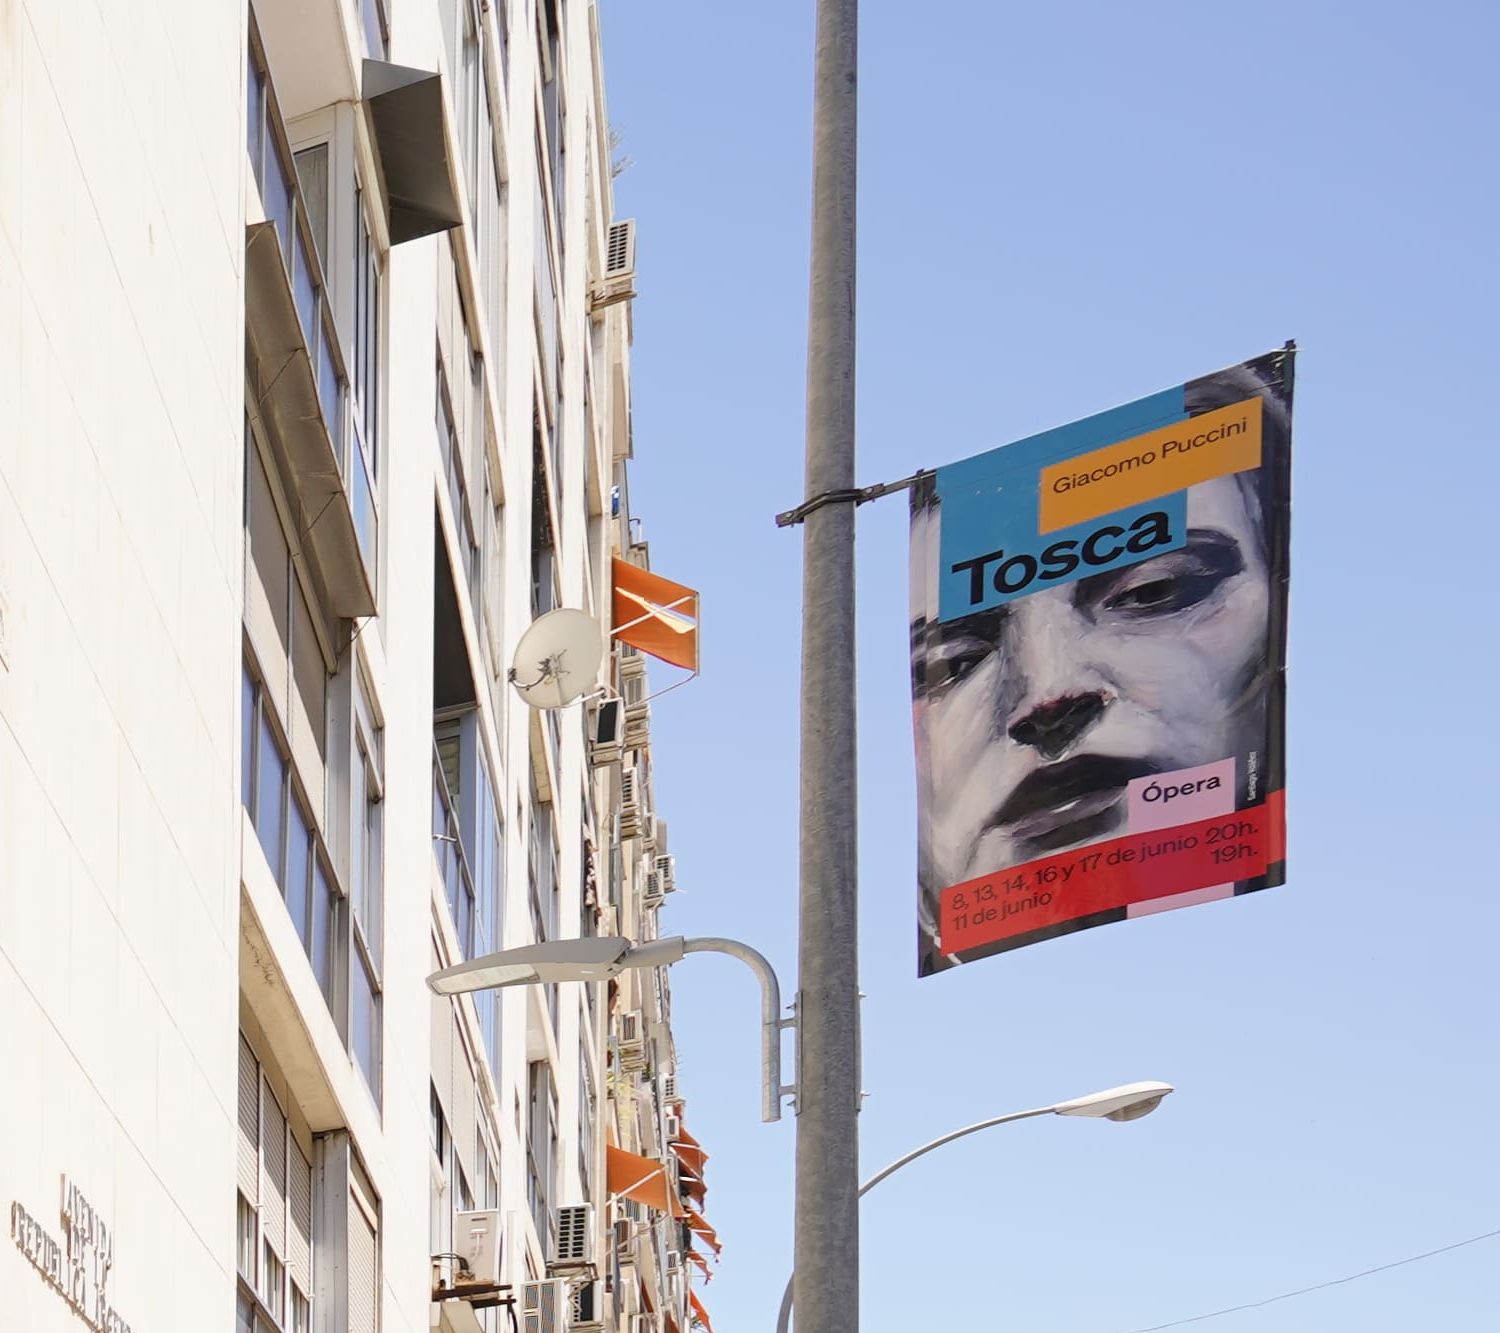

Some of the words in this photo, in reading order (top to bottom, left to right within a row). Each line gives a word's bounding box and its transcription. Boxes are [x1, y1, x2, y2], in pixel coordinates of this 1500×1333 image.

[1052, 447, 1156, 495] Giacomo
[1162, 417, 1248, 459] Puccini
[951, 511, 1172, 606] Tosca
[1141, 773, 1221, 807] Ópera
[951, 892, 969, 911] 8,
[973, 886, 997, 903] 13,
[1001, 875, 1030, 895] 14,
[1036, 866, 1058, 886] 16
[1061, 862, 1076, 882] y
[1079, 853, 1103, 873] 17
[1106, 846, 1135, 866] de
[1139, 835, 1198, 862] junio
[1205, 822, 1259, 846] 20h.
[952, 916, 969, 930] 11
[972, 908, 997, 926] de
[999, 893, 1052, 920] junio
[1211, 843, 1258, 865] 19h.
